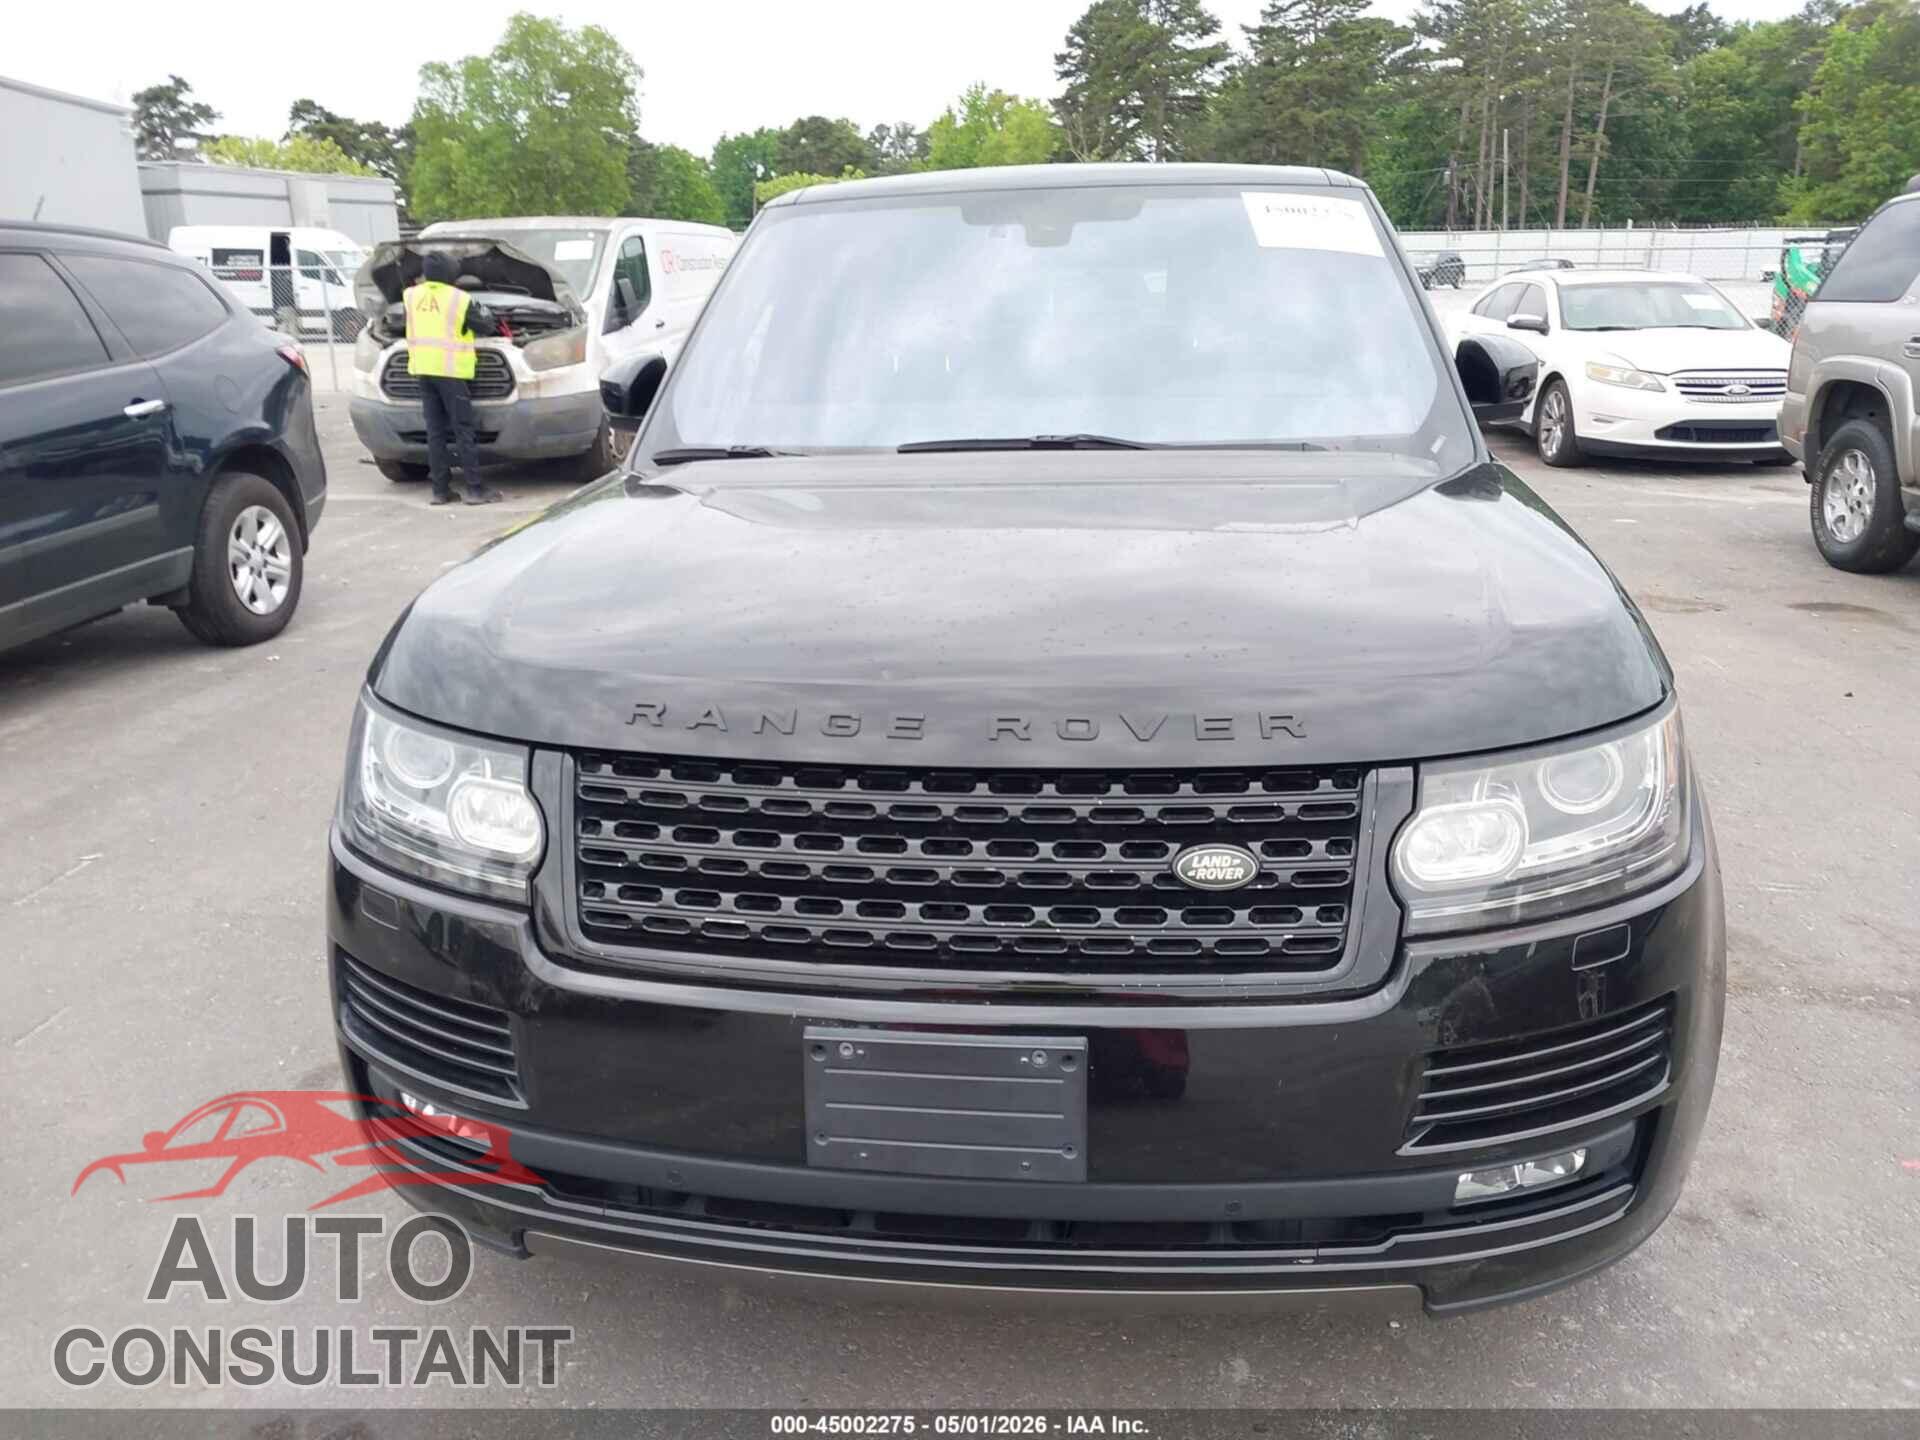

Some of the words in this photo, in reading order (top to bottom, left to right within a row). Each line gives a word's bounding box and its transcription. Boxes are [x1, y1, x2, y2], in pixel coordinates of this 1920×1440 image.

[625, 702, 926, 741] RANGE
[988, 710, 1308, 743] ROVER
[1195, 867, 1244, 880] ROVER
